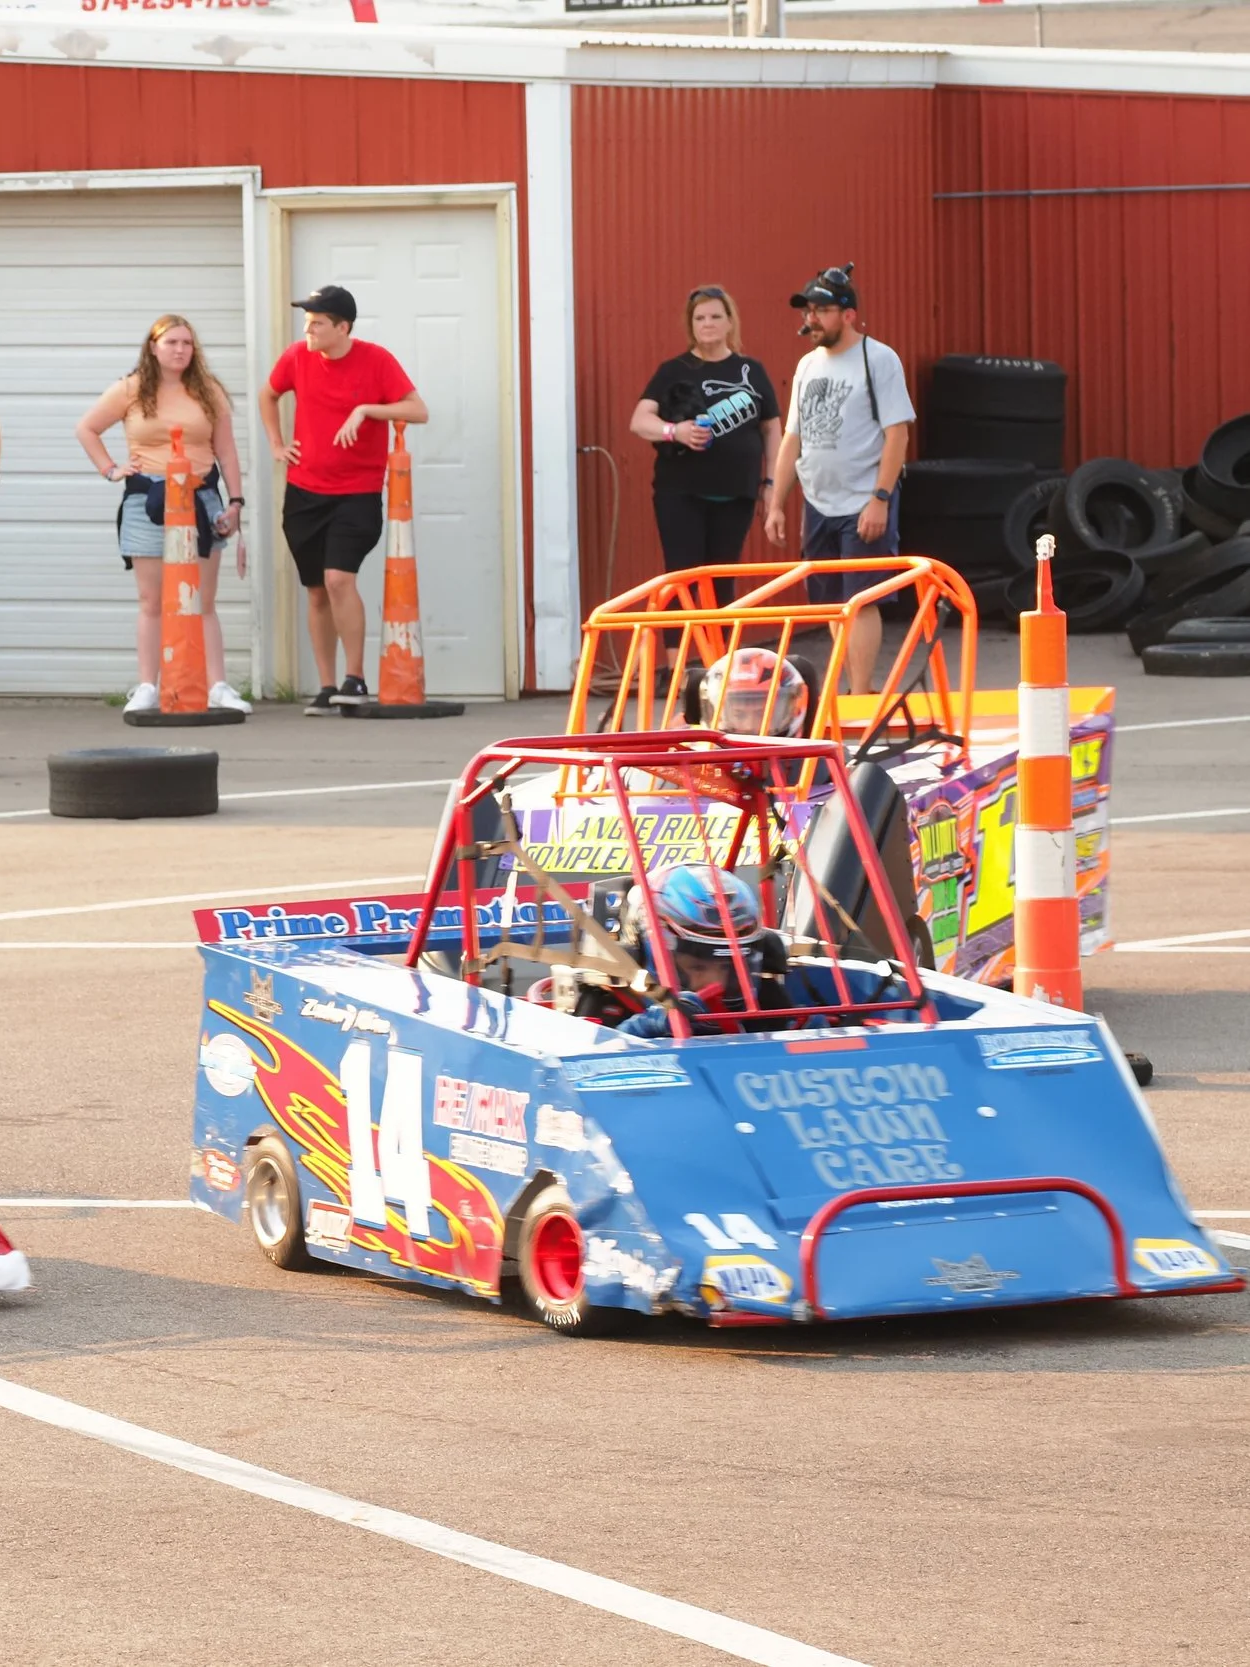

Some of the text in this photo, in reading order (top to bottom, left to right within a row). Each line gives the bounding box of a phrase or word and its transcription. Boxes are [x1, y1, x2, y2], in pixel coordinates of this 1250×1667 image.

[218, 909, 348, 940] Prime
[339, 1037, 433, 1242] 14
[682, 1212, 779, 1250] 14
[716, 1266, 783, 1298] NAPA
